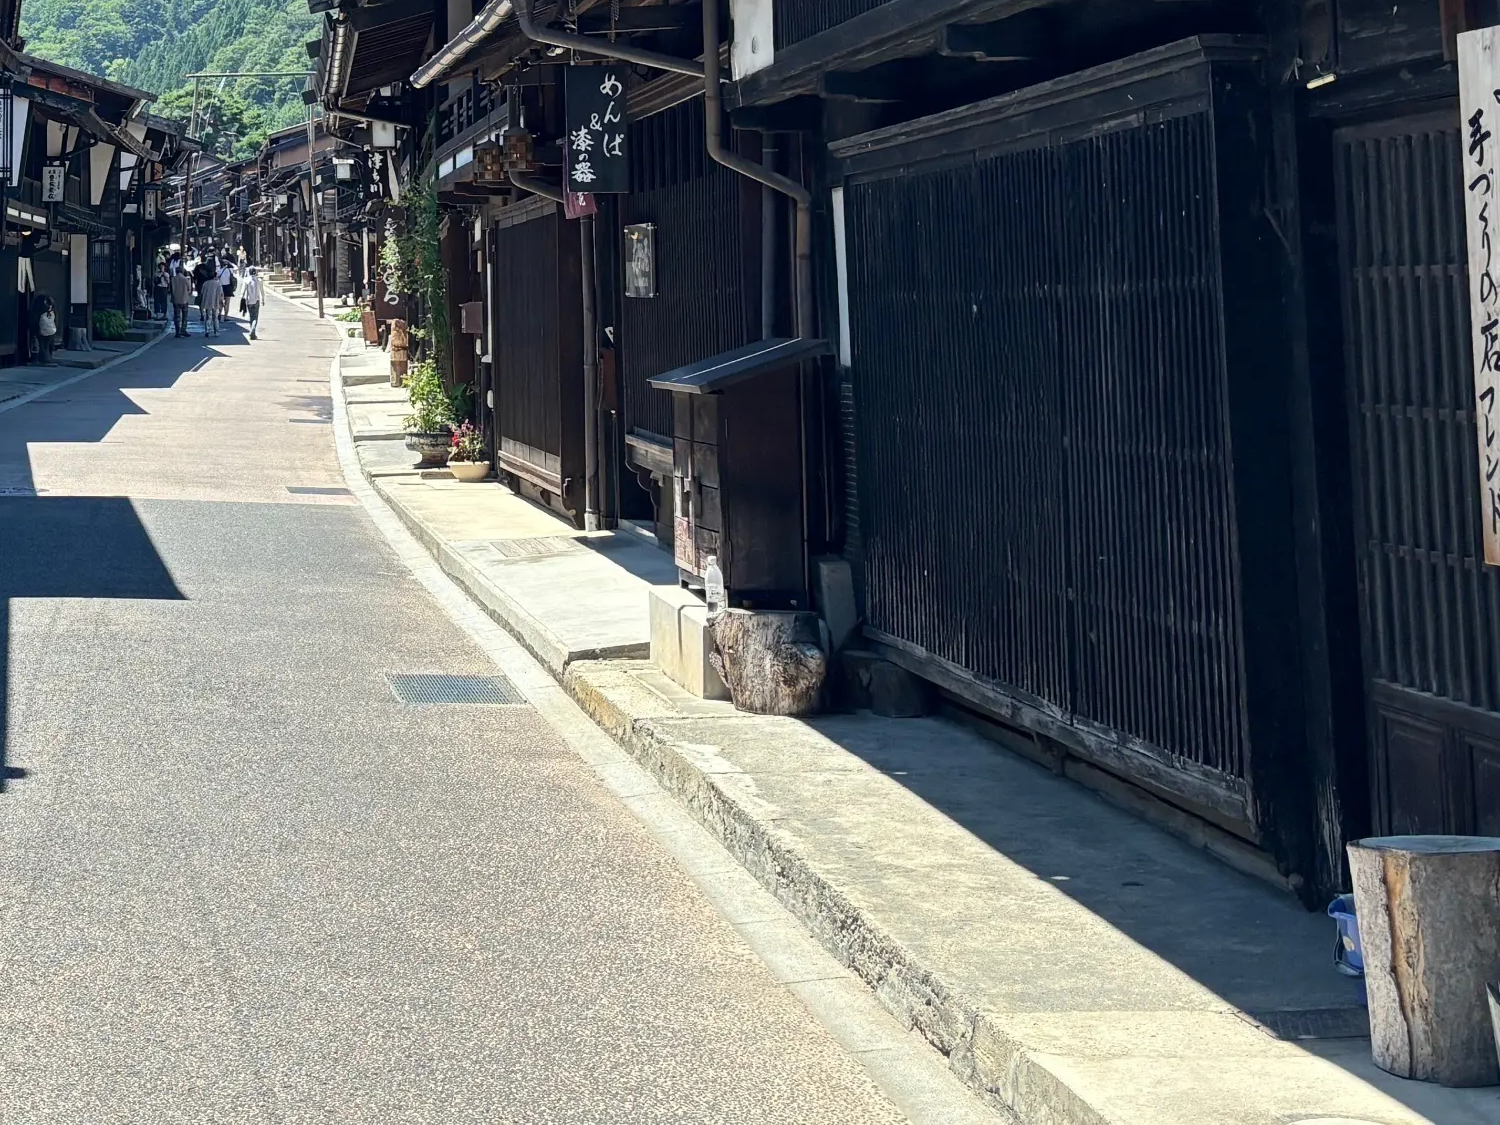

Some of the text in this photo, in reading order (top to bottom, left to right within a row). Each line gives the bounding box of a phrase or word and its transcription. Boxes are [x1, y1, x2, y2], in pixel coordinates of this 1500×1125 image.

[590, 113, 602, 131] &
[570, 125, 596, 183] 漆の器
